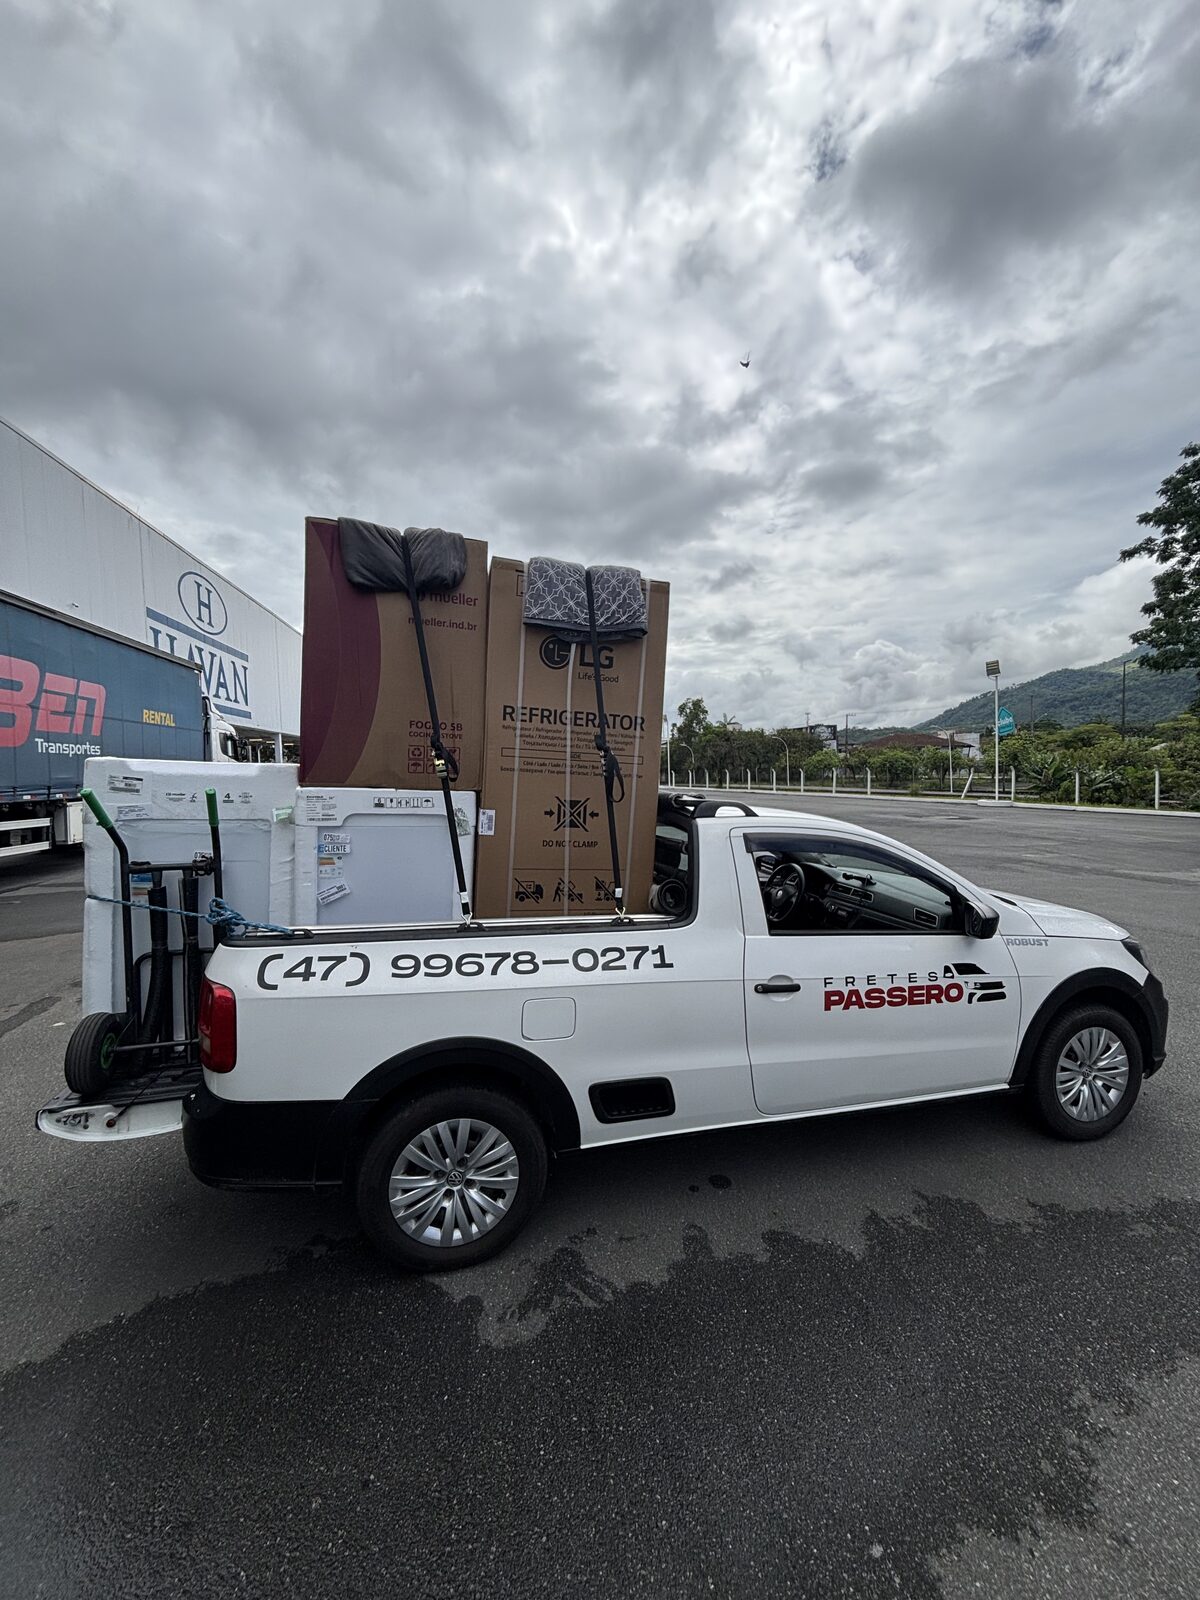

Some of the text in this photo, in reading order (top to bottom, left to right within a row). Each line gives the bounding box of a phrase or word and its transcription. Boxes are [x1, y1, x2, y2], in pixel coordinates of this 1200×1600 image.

[194, 580, 215, 628] H
[430, 592, 479, 607] mueller
[408, 617, 478, 631] meller.ind.br
[600, 673, 619, 683] Good
[142, 708, 176, 727] RENTAL
[409, 720, 463, 731] FOGO SB
[409, 730, 435, 738] COCIN
[34, 738, 101, 757] Transportes
[542, 840, 598, 849] DO NO CLAMP
[1006, 938, 1049, 947] ROBUST
[257, 944, 675, 991] (47) 99678-0271
[823, 971, 939, 988] FRETES
[823, 982, 964, 1011] PASSERO
